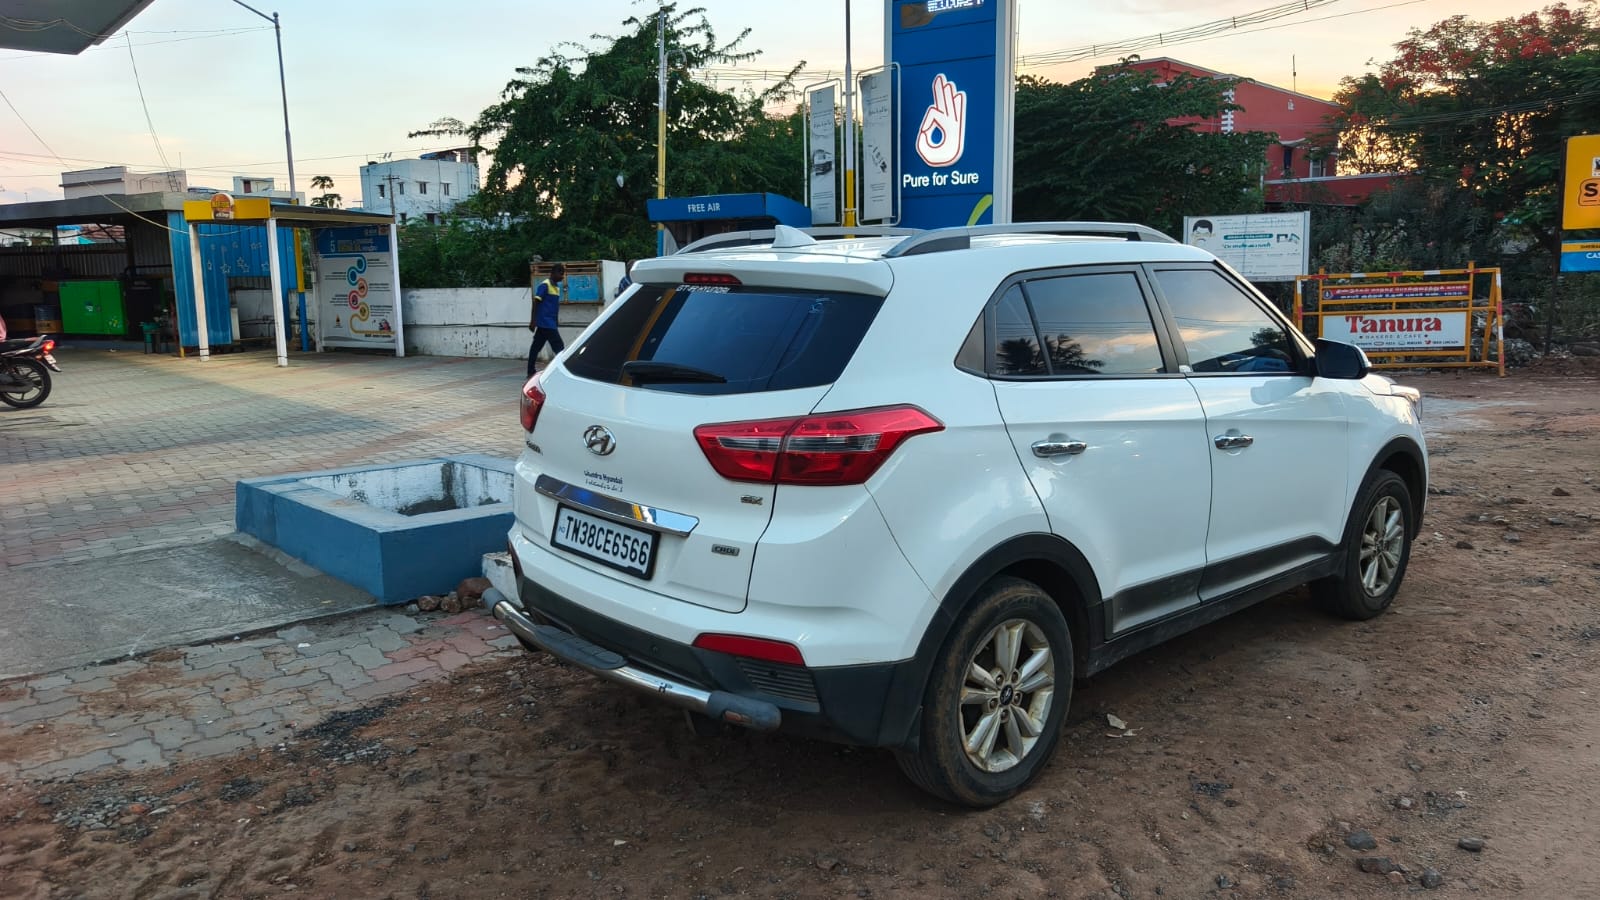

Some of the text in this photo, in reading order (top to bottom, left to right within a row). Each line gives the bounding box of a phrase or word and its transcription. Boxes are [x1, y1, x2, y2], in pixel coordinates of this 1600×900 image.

[903, 170, 979, 188] Pure for Sure
[687, 202, 721, 213] FREE AIR
[1345, 315, 1442, 333] Tanura
[565, 515, 650, 566] TN38CE6566
